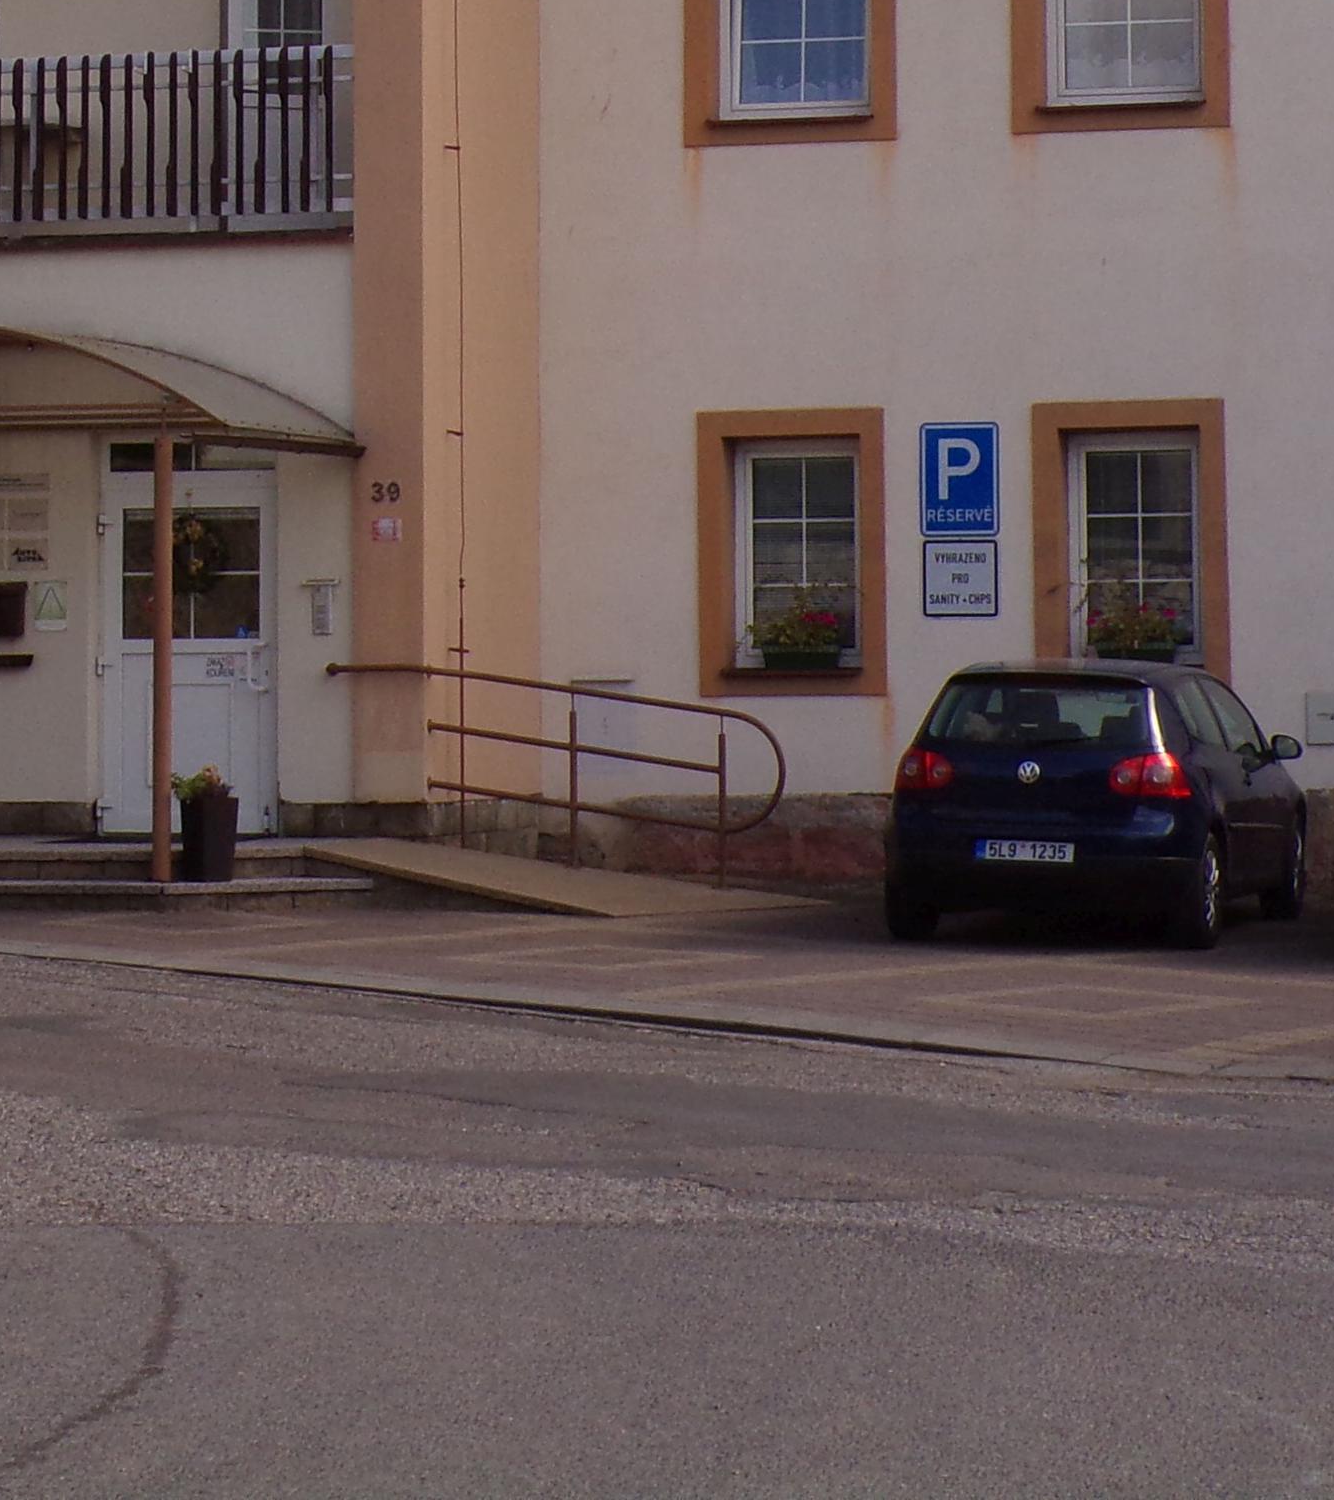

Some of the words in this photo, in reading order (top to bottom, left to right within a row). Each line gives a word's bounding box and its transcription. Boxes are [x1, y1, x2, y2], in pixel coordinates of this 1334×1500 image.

[938, 438, 981, 500] P
[371, 481, 400, 503] 39
[927, 506, 992, 523] RÉSERVÉ
[934, 552, 986, 564] VYHRAZENO
[951, 572, 969, 584] PRO
[929, 594, 960, 605] SANITY
[988, 842, 1017, 858] 5L9
[1029, 843, 1067, 860] 1235
